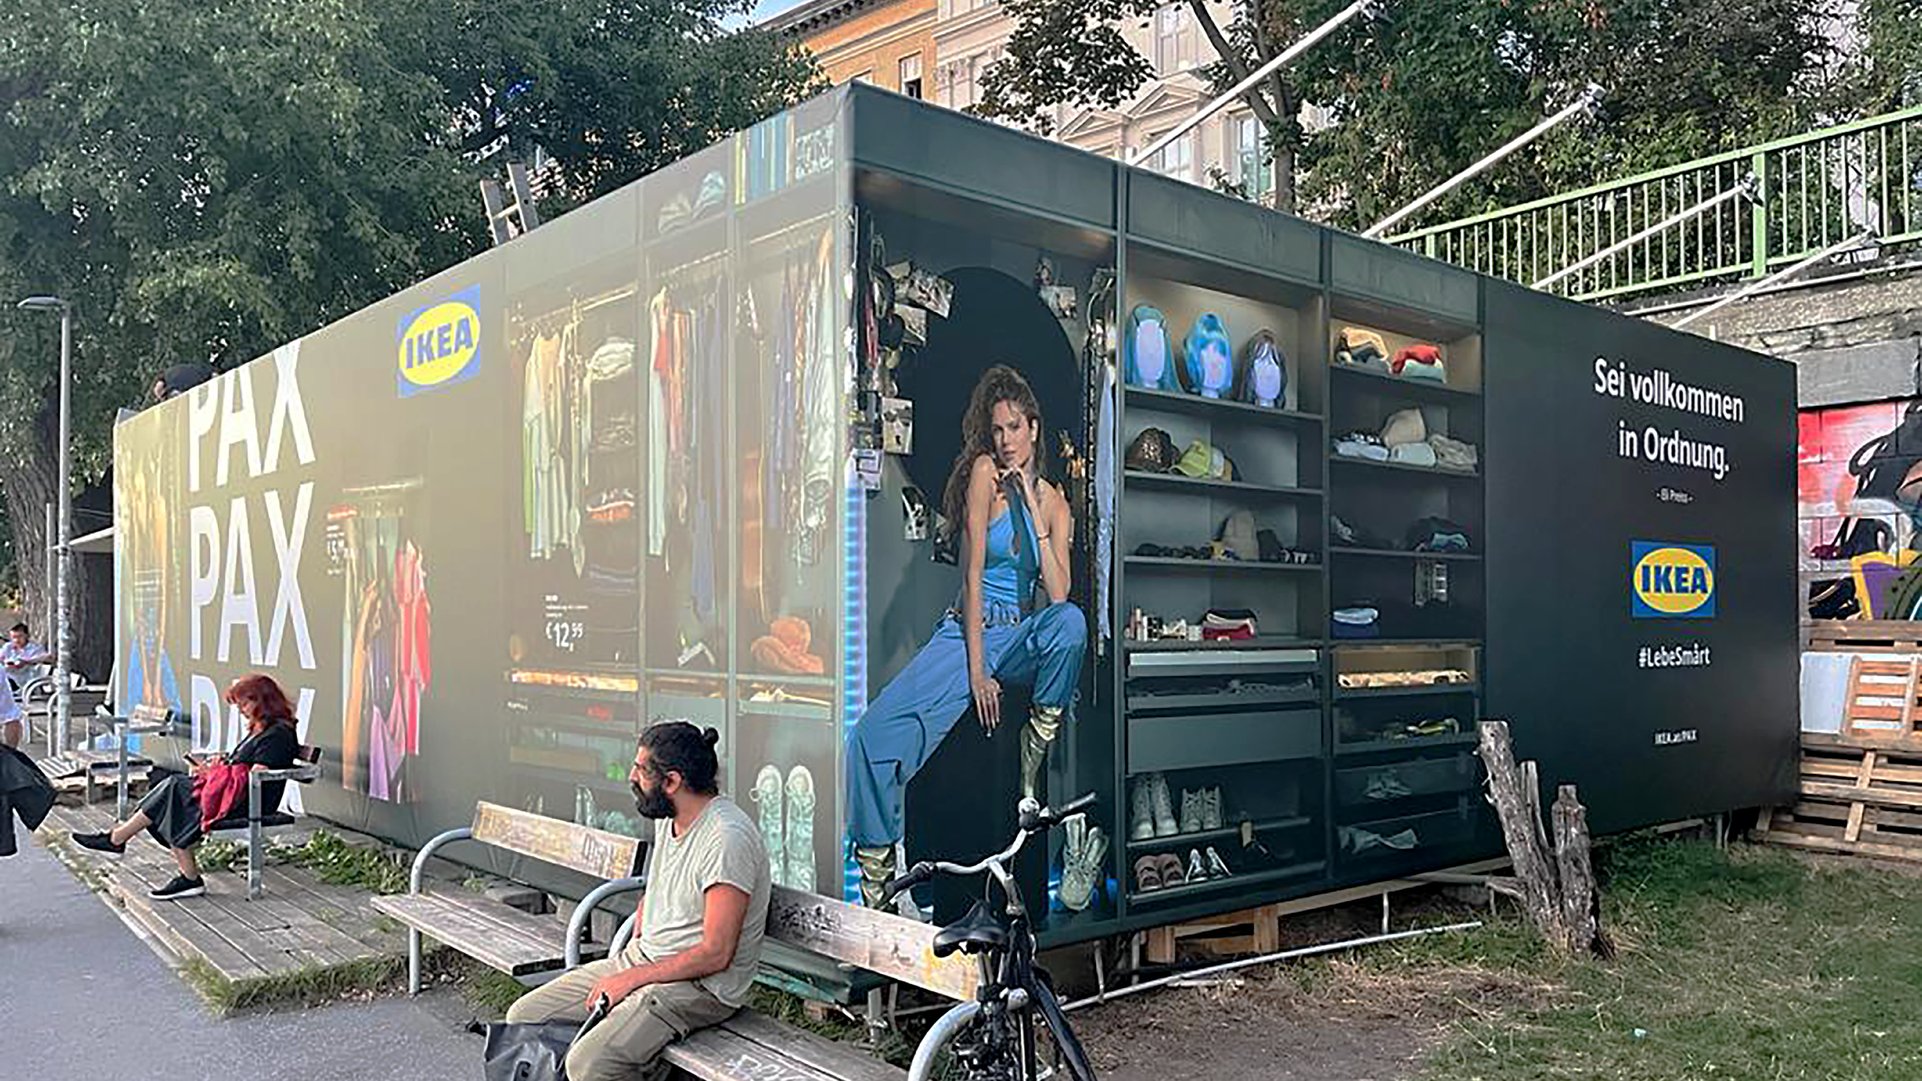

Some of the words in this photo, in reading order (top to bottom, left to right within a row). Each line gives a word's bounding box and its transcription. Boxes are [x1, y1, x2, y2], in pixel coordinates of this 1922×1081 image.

[406, 316, 474, 369] IKEA
[188, 340, 316, 492] PAX
[1595, 358, 1626, 398] Sei
[1629, 369, 1744, 422] vollkommen
[1619, 420, 1639, 458] in
[1643, 427, 1730, 480] Ordnung.
[190, 481, 317, 669] PAX
[1641, 565, 1709, 594] IKEA
